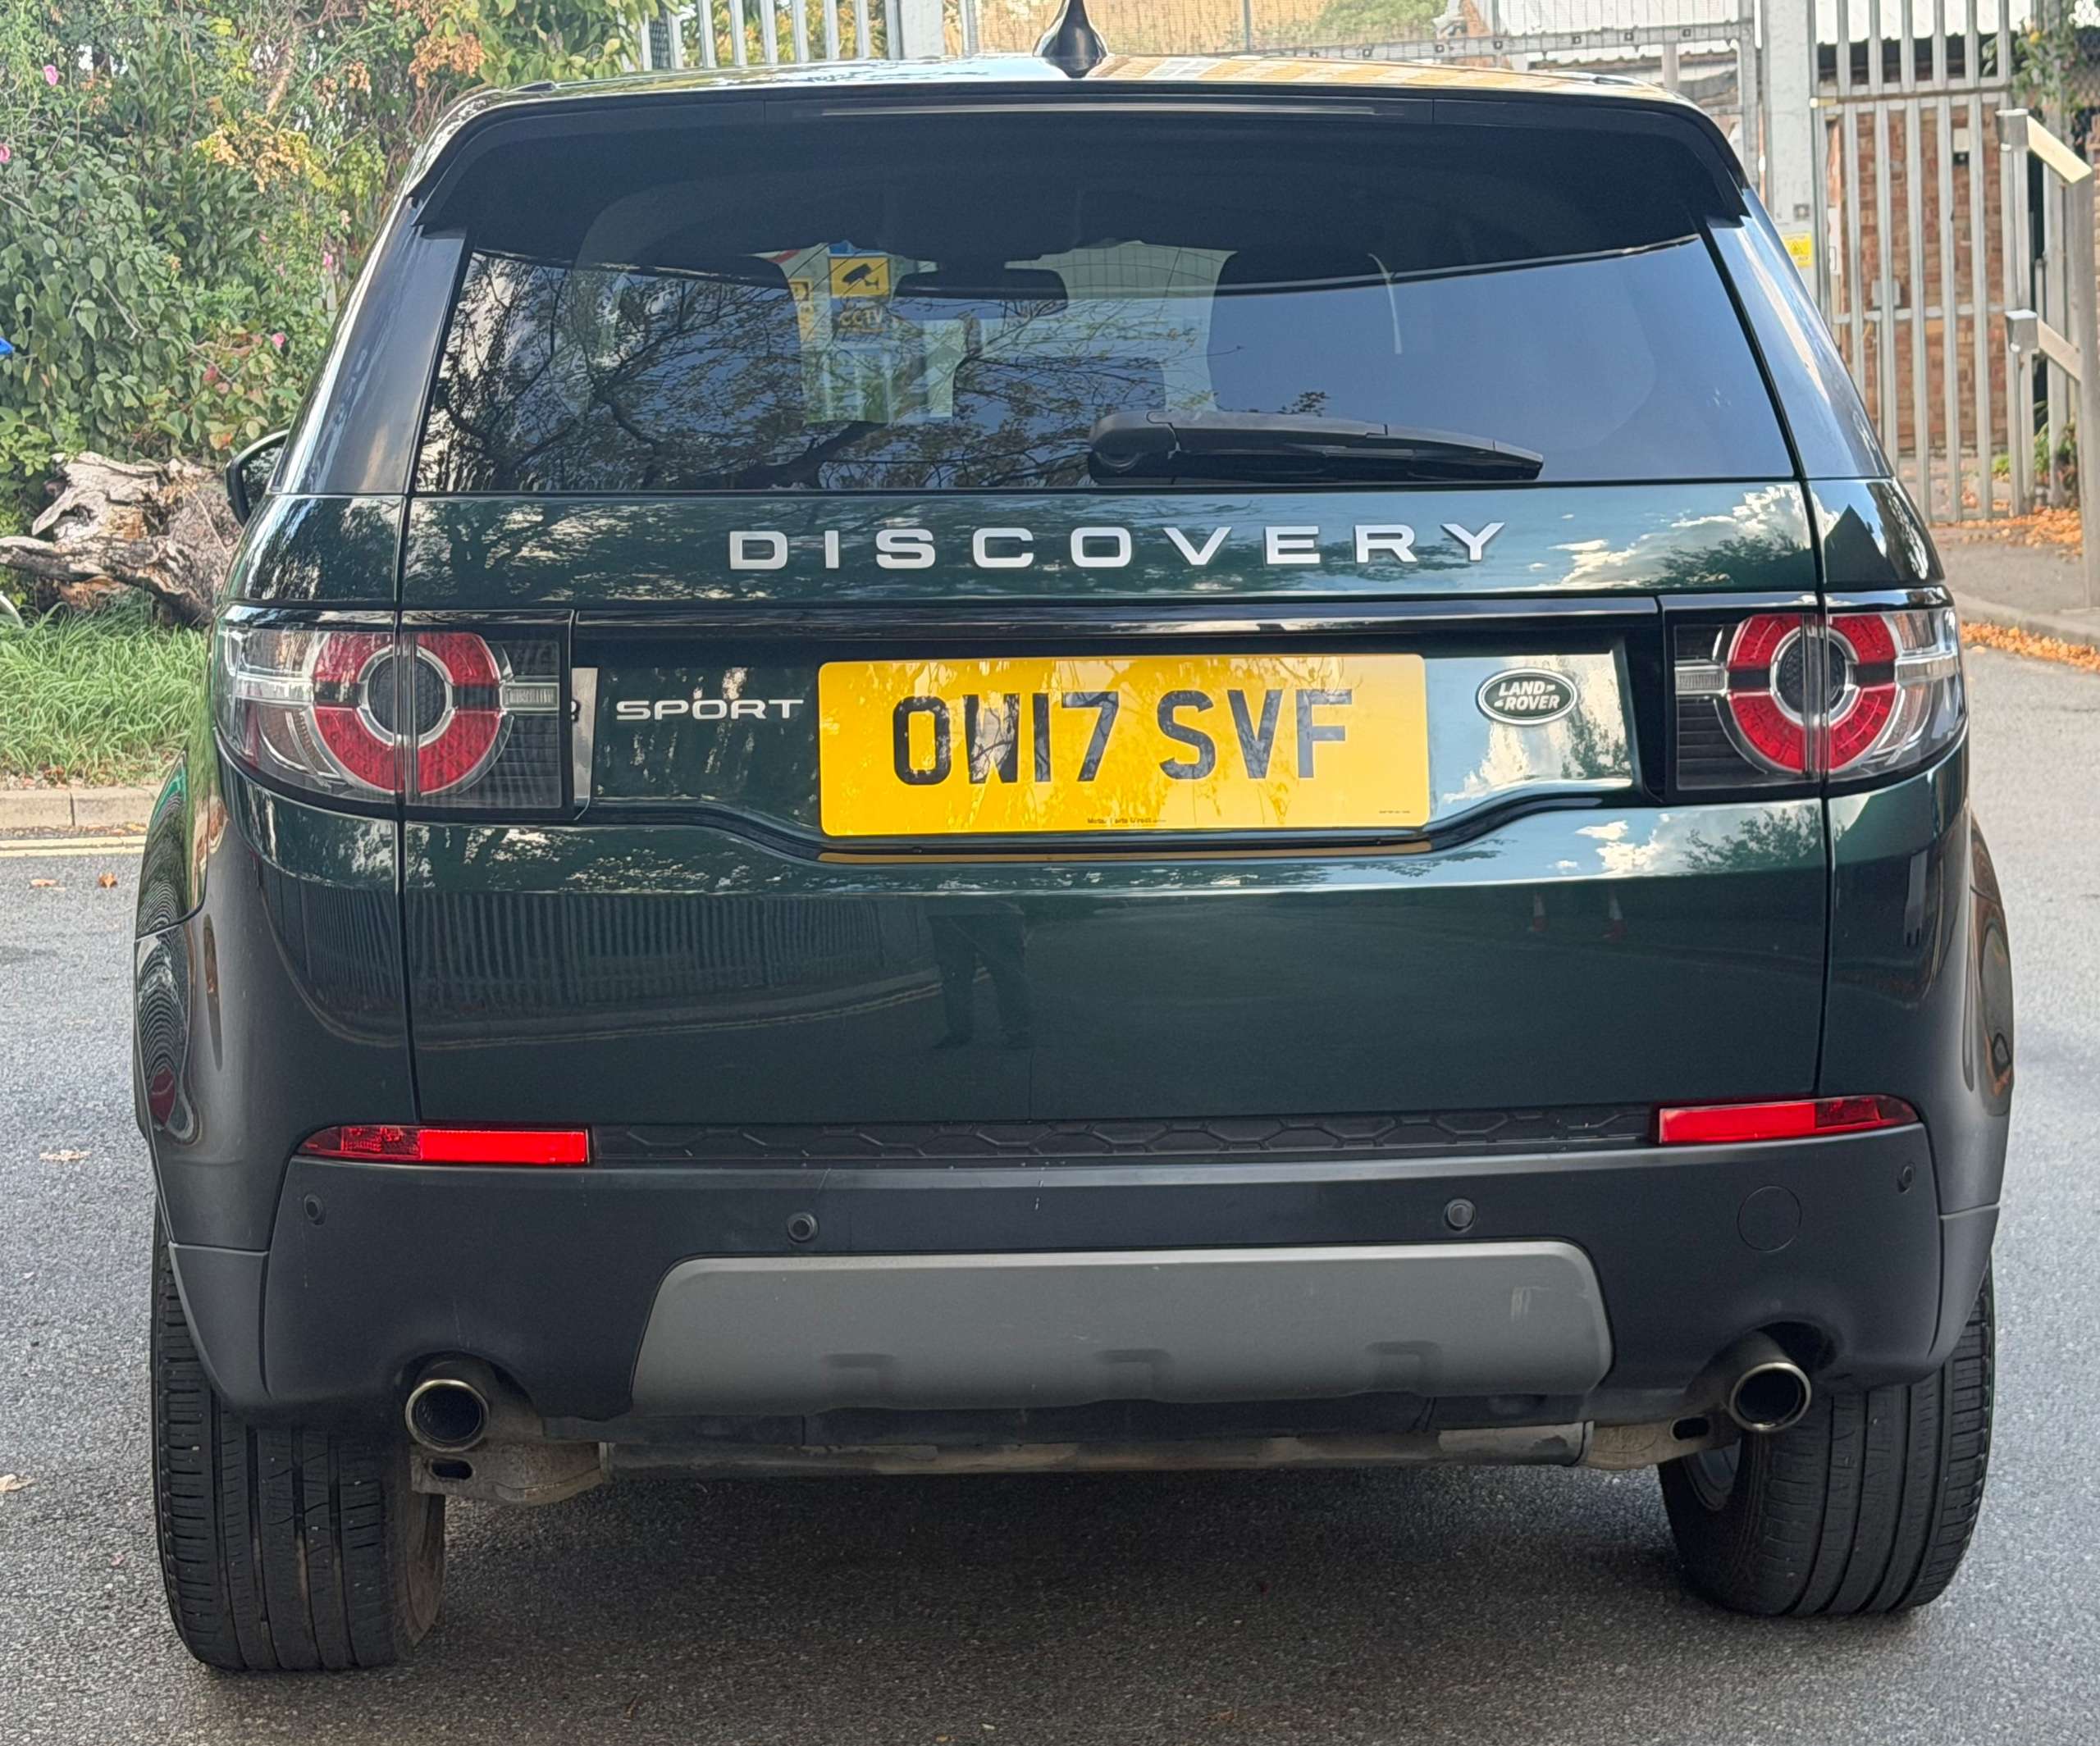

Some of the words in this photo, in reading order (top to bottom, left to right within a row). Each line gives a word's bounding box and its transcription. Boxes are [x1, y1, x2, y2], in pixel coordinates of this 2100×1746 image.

[728, 522, 1505, 570] DISCOVERY
[1499, 681, 1545, 696] LAND
[616, 699, 804, 721] SPORT
[1504, 695, 1560, 710] ROVER
[892, 691, 1120, 786] OW17
[1157, 689, 1353, 780] SVF
